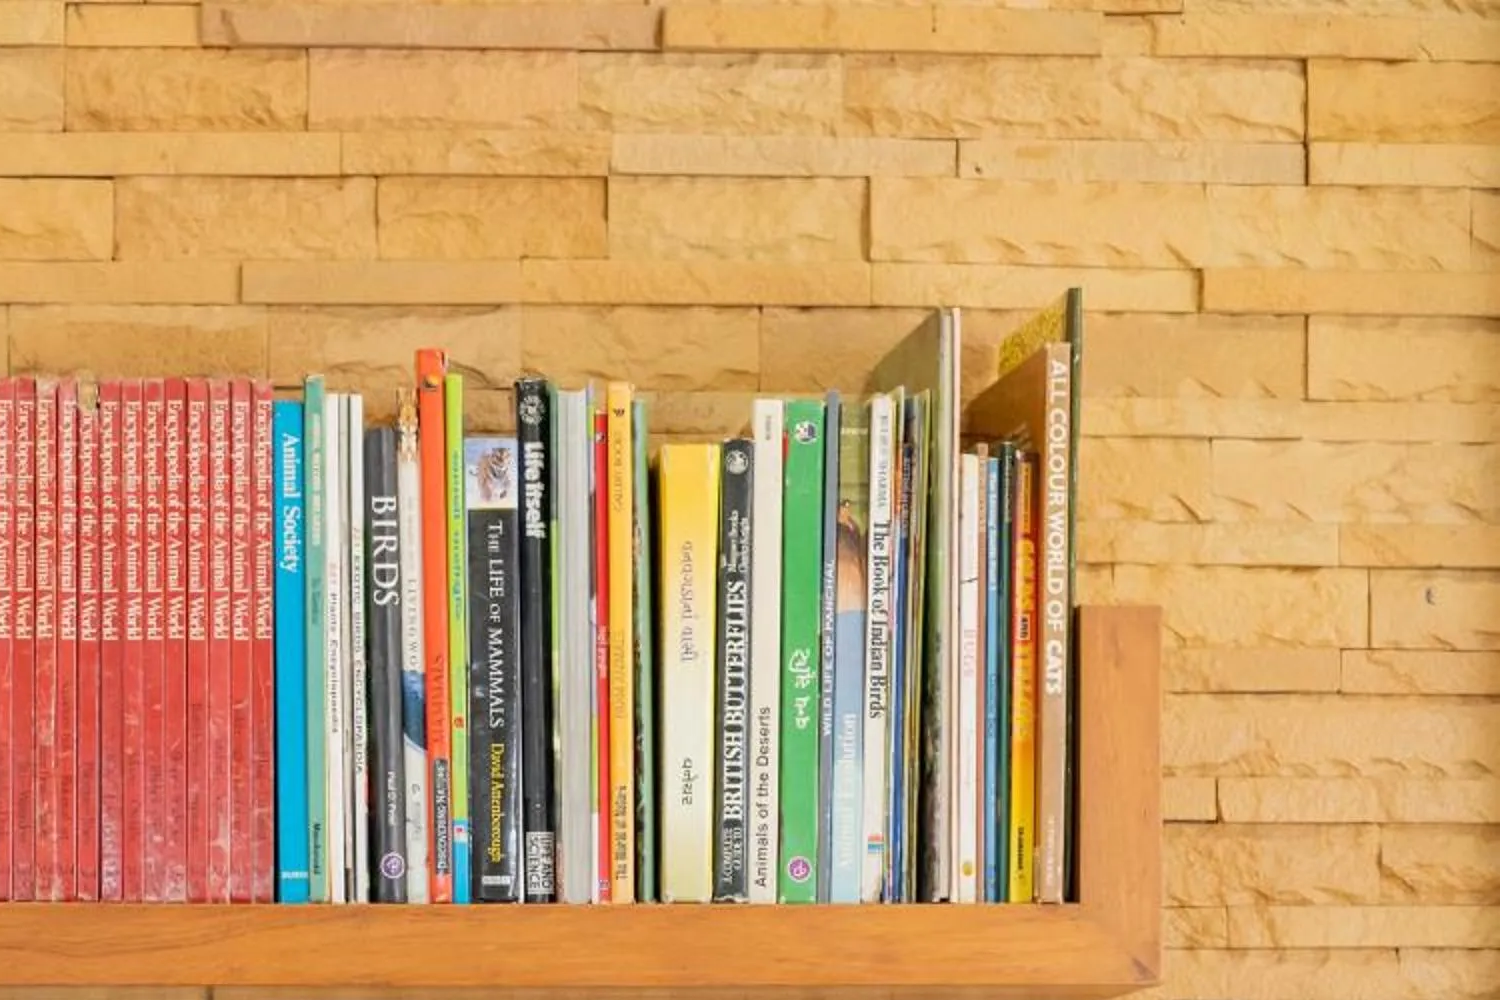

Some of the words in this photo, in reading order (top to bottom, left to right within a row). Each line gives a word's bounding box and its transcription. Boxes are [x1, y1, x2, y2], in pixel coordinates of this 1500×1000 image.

[1050, 360, 1068, 405] ALL
[283, 433, 301, 498] Animal
[523, 441, 545, 481] Life
[1048, 407, 1068, 506] COLOUR
[103, 495, 118, 508] of
[168, 494, 183, 508] of
[233, 495, 249, 508] of
[256, 494, 272, 506] of
[103, 513, 118, 536] the
[168, 512, 183, 535] the
[233, 513, 249, 535] the
[256, 512, 272, 534] the
[277, 505, 301, 573] Society
[872, 520, 891, 550] The
[103, 539, 118, 593] Animal
[168, 538, 183, 591] Animal
[233, 540, 249, 592] Animal
[256, 537, 272, 591] Animal
[372, 496, 400, 606] BIRDS
[1047, 511, 1066, 594] WORLD
[489, 559, 503, 597] LIFE
[825, 560, 835, 630] PANCHAL
[872, 554, 890, 595] Book
[103, 598, 118, 640] World
[168, 596, 183, 639] World
[233, 597, 249, 640] World
[256, 595, 272, 639] World
[407, 579, 418, 638] LIVING
[871, 598, 888, 616] of
[1046, 600, 1063, 633] OF
[723, 581, 746, 726] BUTTERFLIES
[824, 634, 834, 657] OF
[869, 619, 888, 672] Indian
[488, 628, 504, 728] MAMMALS
[823, 661, 833, 693] LIFE
[1045, 639, 1063, 696] CATS
[823, 697, 833, 738] WILD
[868, 675, 888, 719] Birds
[755, 707, 771, 767] Deserts
[838, 713, 857, 799] Evolution
[491, 743, 505, 779] David
[723, 731, 744, 821] BRITISH
[755, 773, 769, 797] the
[488, 781, 505, 862] Attenborough
[754, 800, 768, 818] of
[529, 837, 541, 888] SCIENCE
[542, 864, 553, 888] AND
[754, 824, 768, 888] Animals
